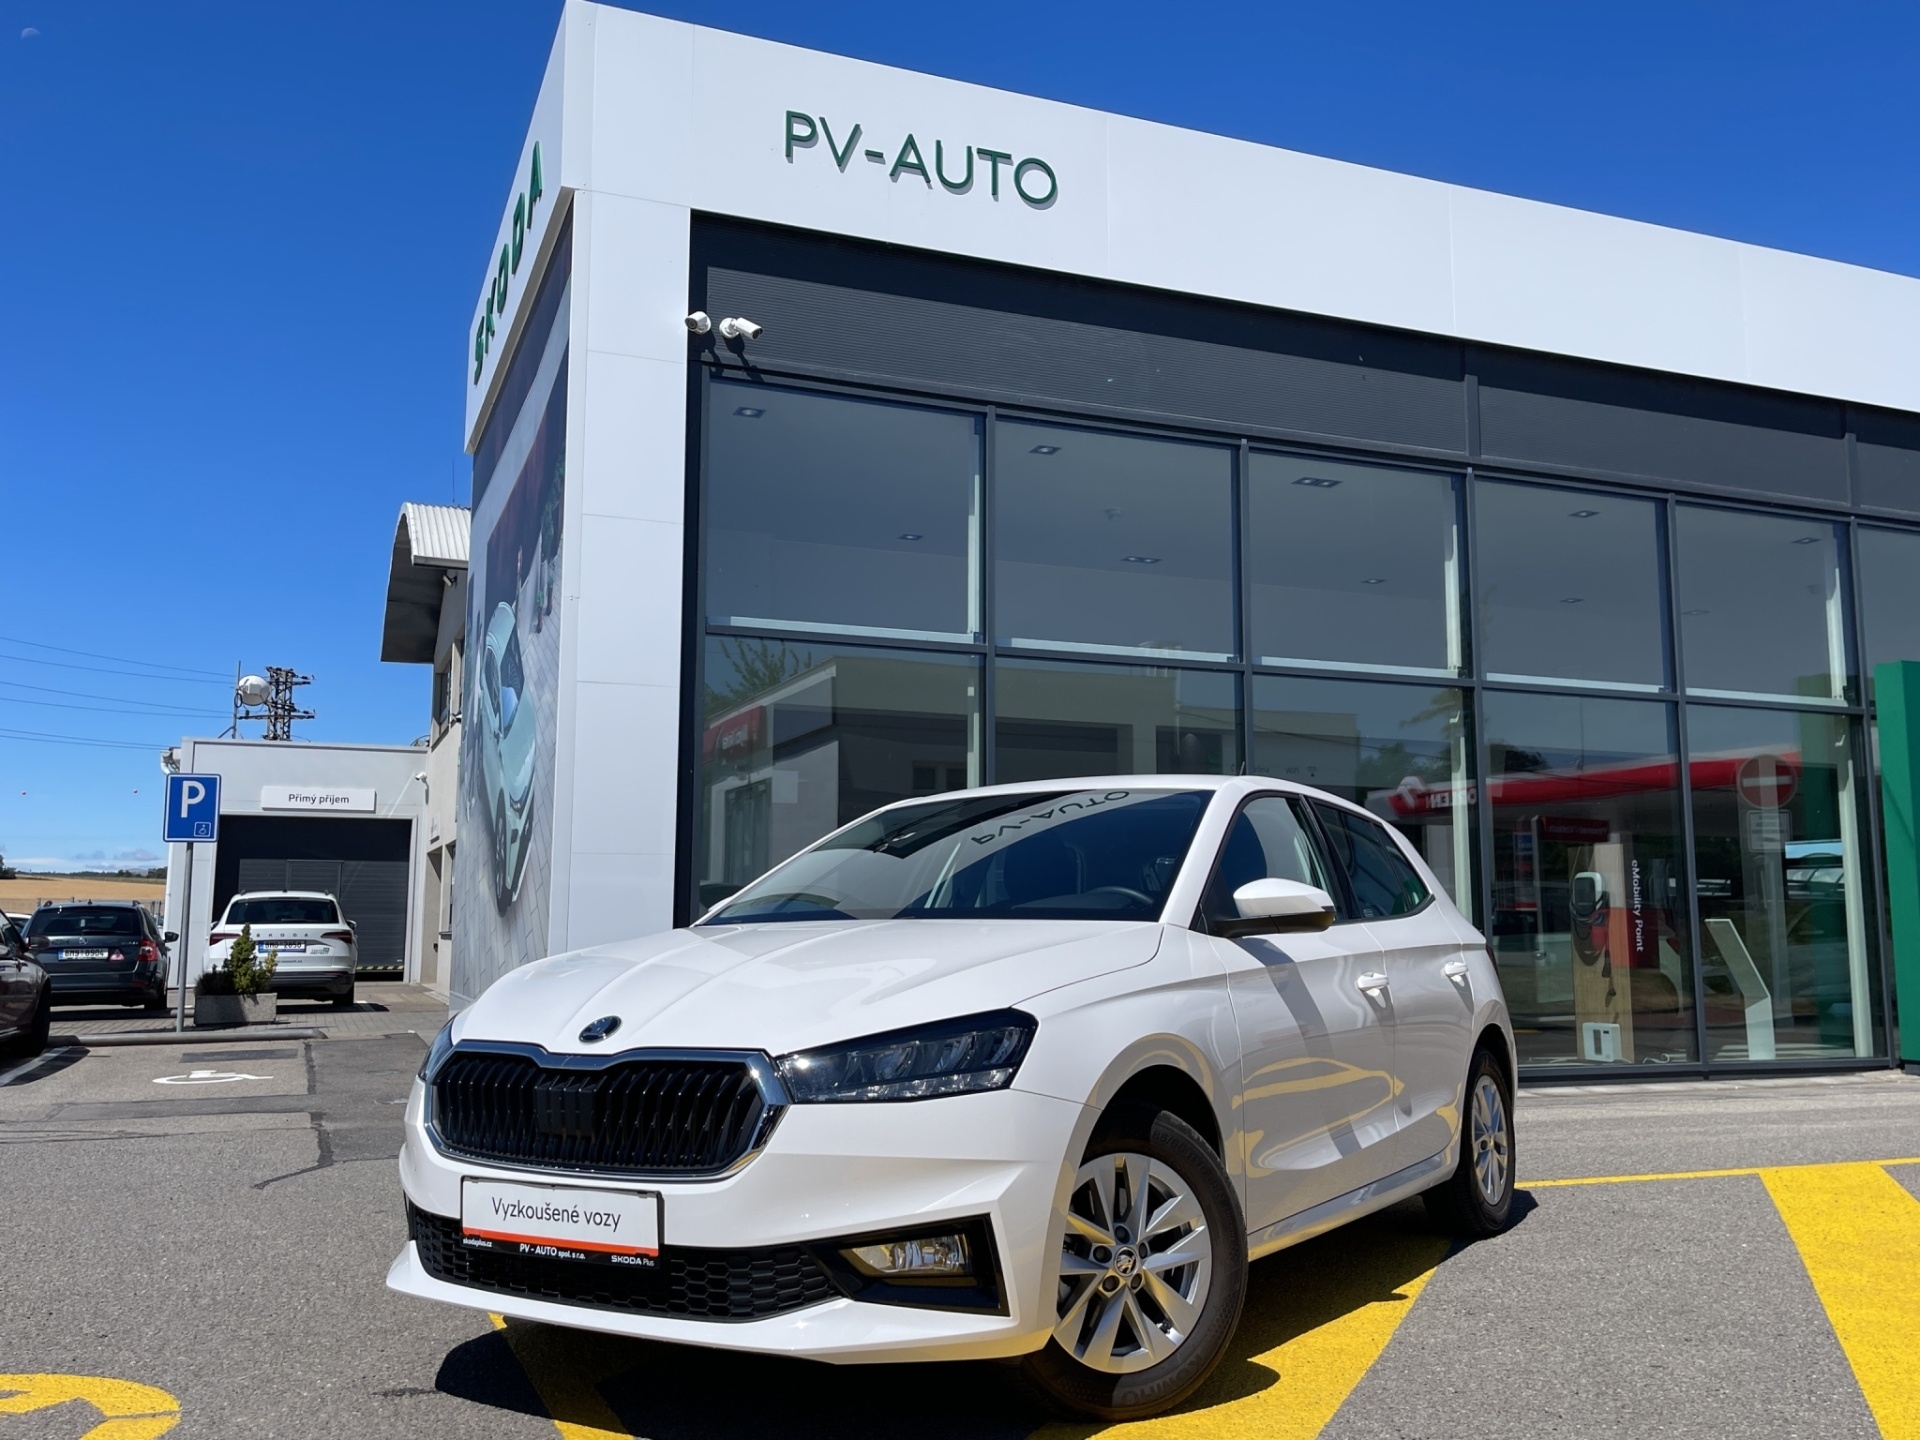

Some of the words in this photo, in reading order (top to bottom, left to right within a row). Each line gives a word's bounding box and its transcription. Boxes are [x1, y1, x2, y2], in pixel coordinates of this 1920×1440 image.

[785, 110, 1057, 205] PV-AUTO
[180, 780, 206, 818] P
[1632, 860, 1642, 916] eMobility
[1635, 920, 1643, 952] Point
[491, 1196, 580, 1224] Vyzkoušené
[584, 1210, 621, 1232] vozy
[520, 1243, 530, 1253] PV
[535, 1245, 557, 1256] AUTO
